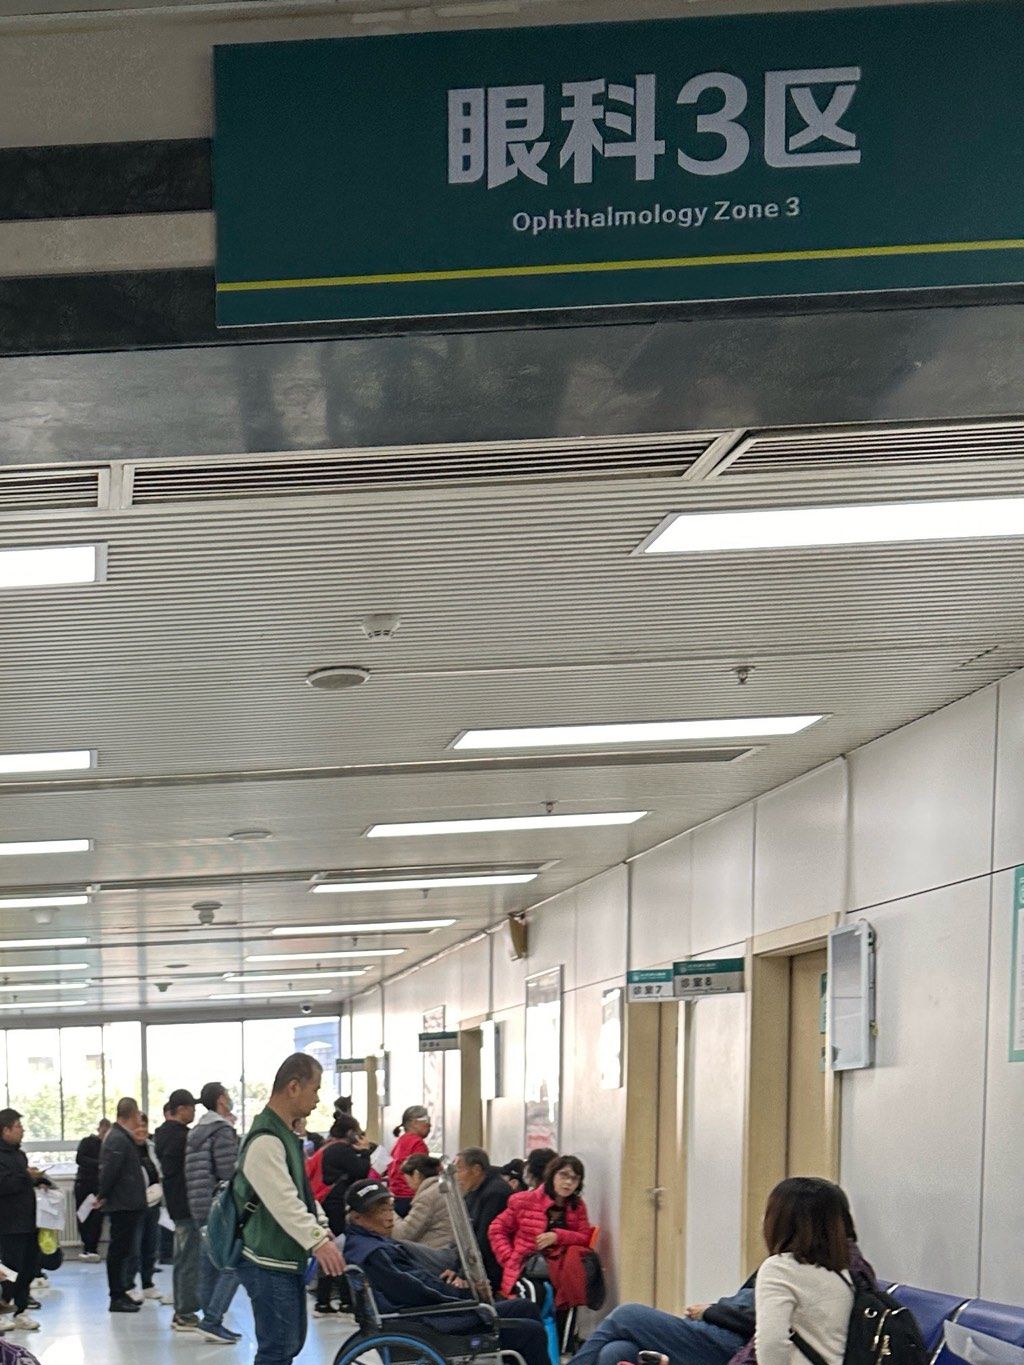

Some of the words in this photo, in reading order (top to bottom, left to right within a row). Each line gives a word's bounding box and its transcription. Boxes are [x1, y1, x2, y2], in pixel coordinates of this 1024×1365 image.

[446, 65, 863, 190] 眼科3区
[512, 203, 707, 233] Ophthalmology
[714, 199, 780, 221] Zone
[785, 196, 801, 217] 3
